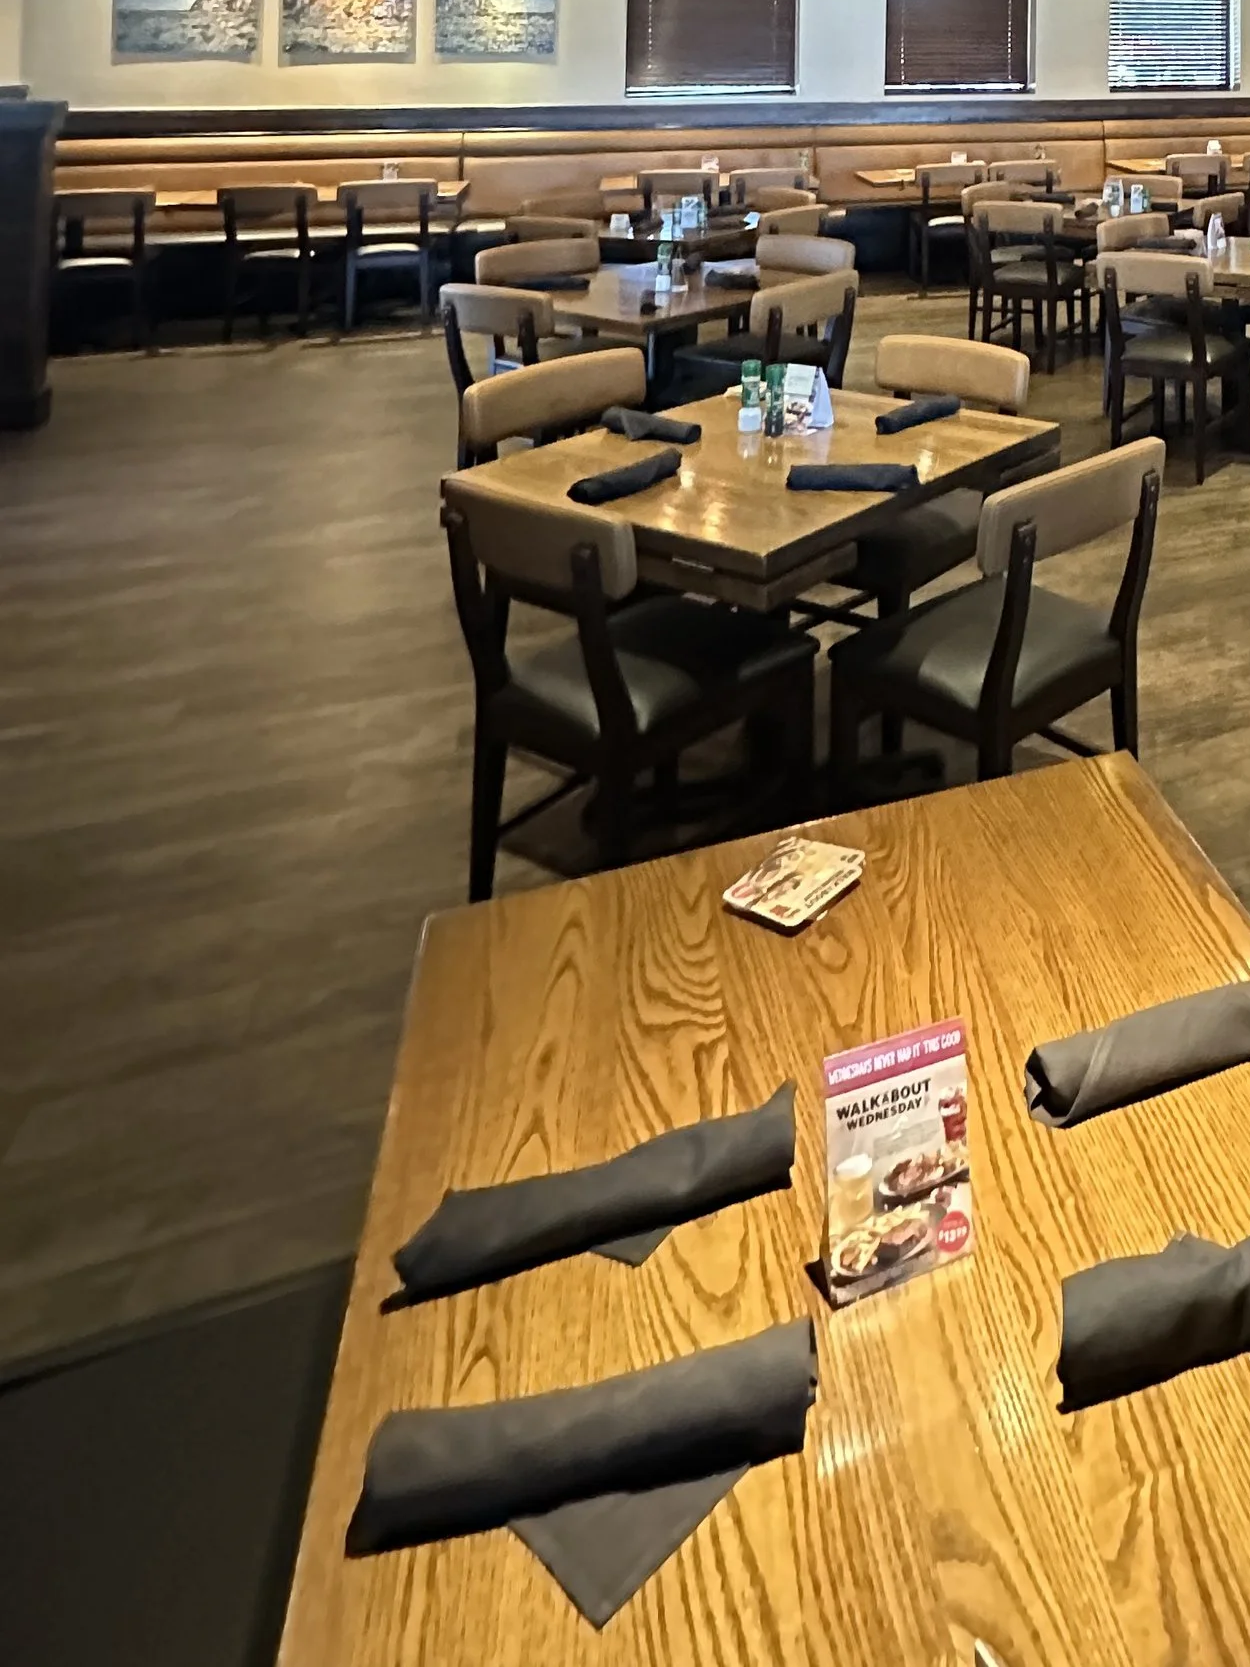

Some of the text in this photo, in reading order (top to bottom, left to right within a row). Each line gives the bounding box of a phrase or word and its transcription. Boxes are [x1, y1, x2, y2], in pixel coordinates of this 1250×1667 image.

[922, 1038, 940, 1054] THIS
[940, 1030, 961, 1049] GOOD
[836, 1078, 931, 1120] WALKABOUT
[847, 1097, 922, 1131] WEDNESDAY
